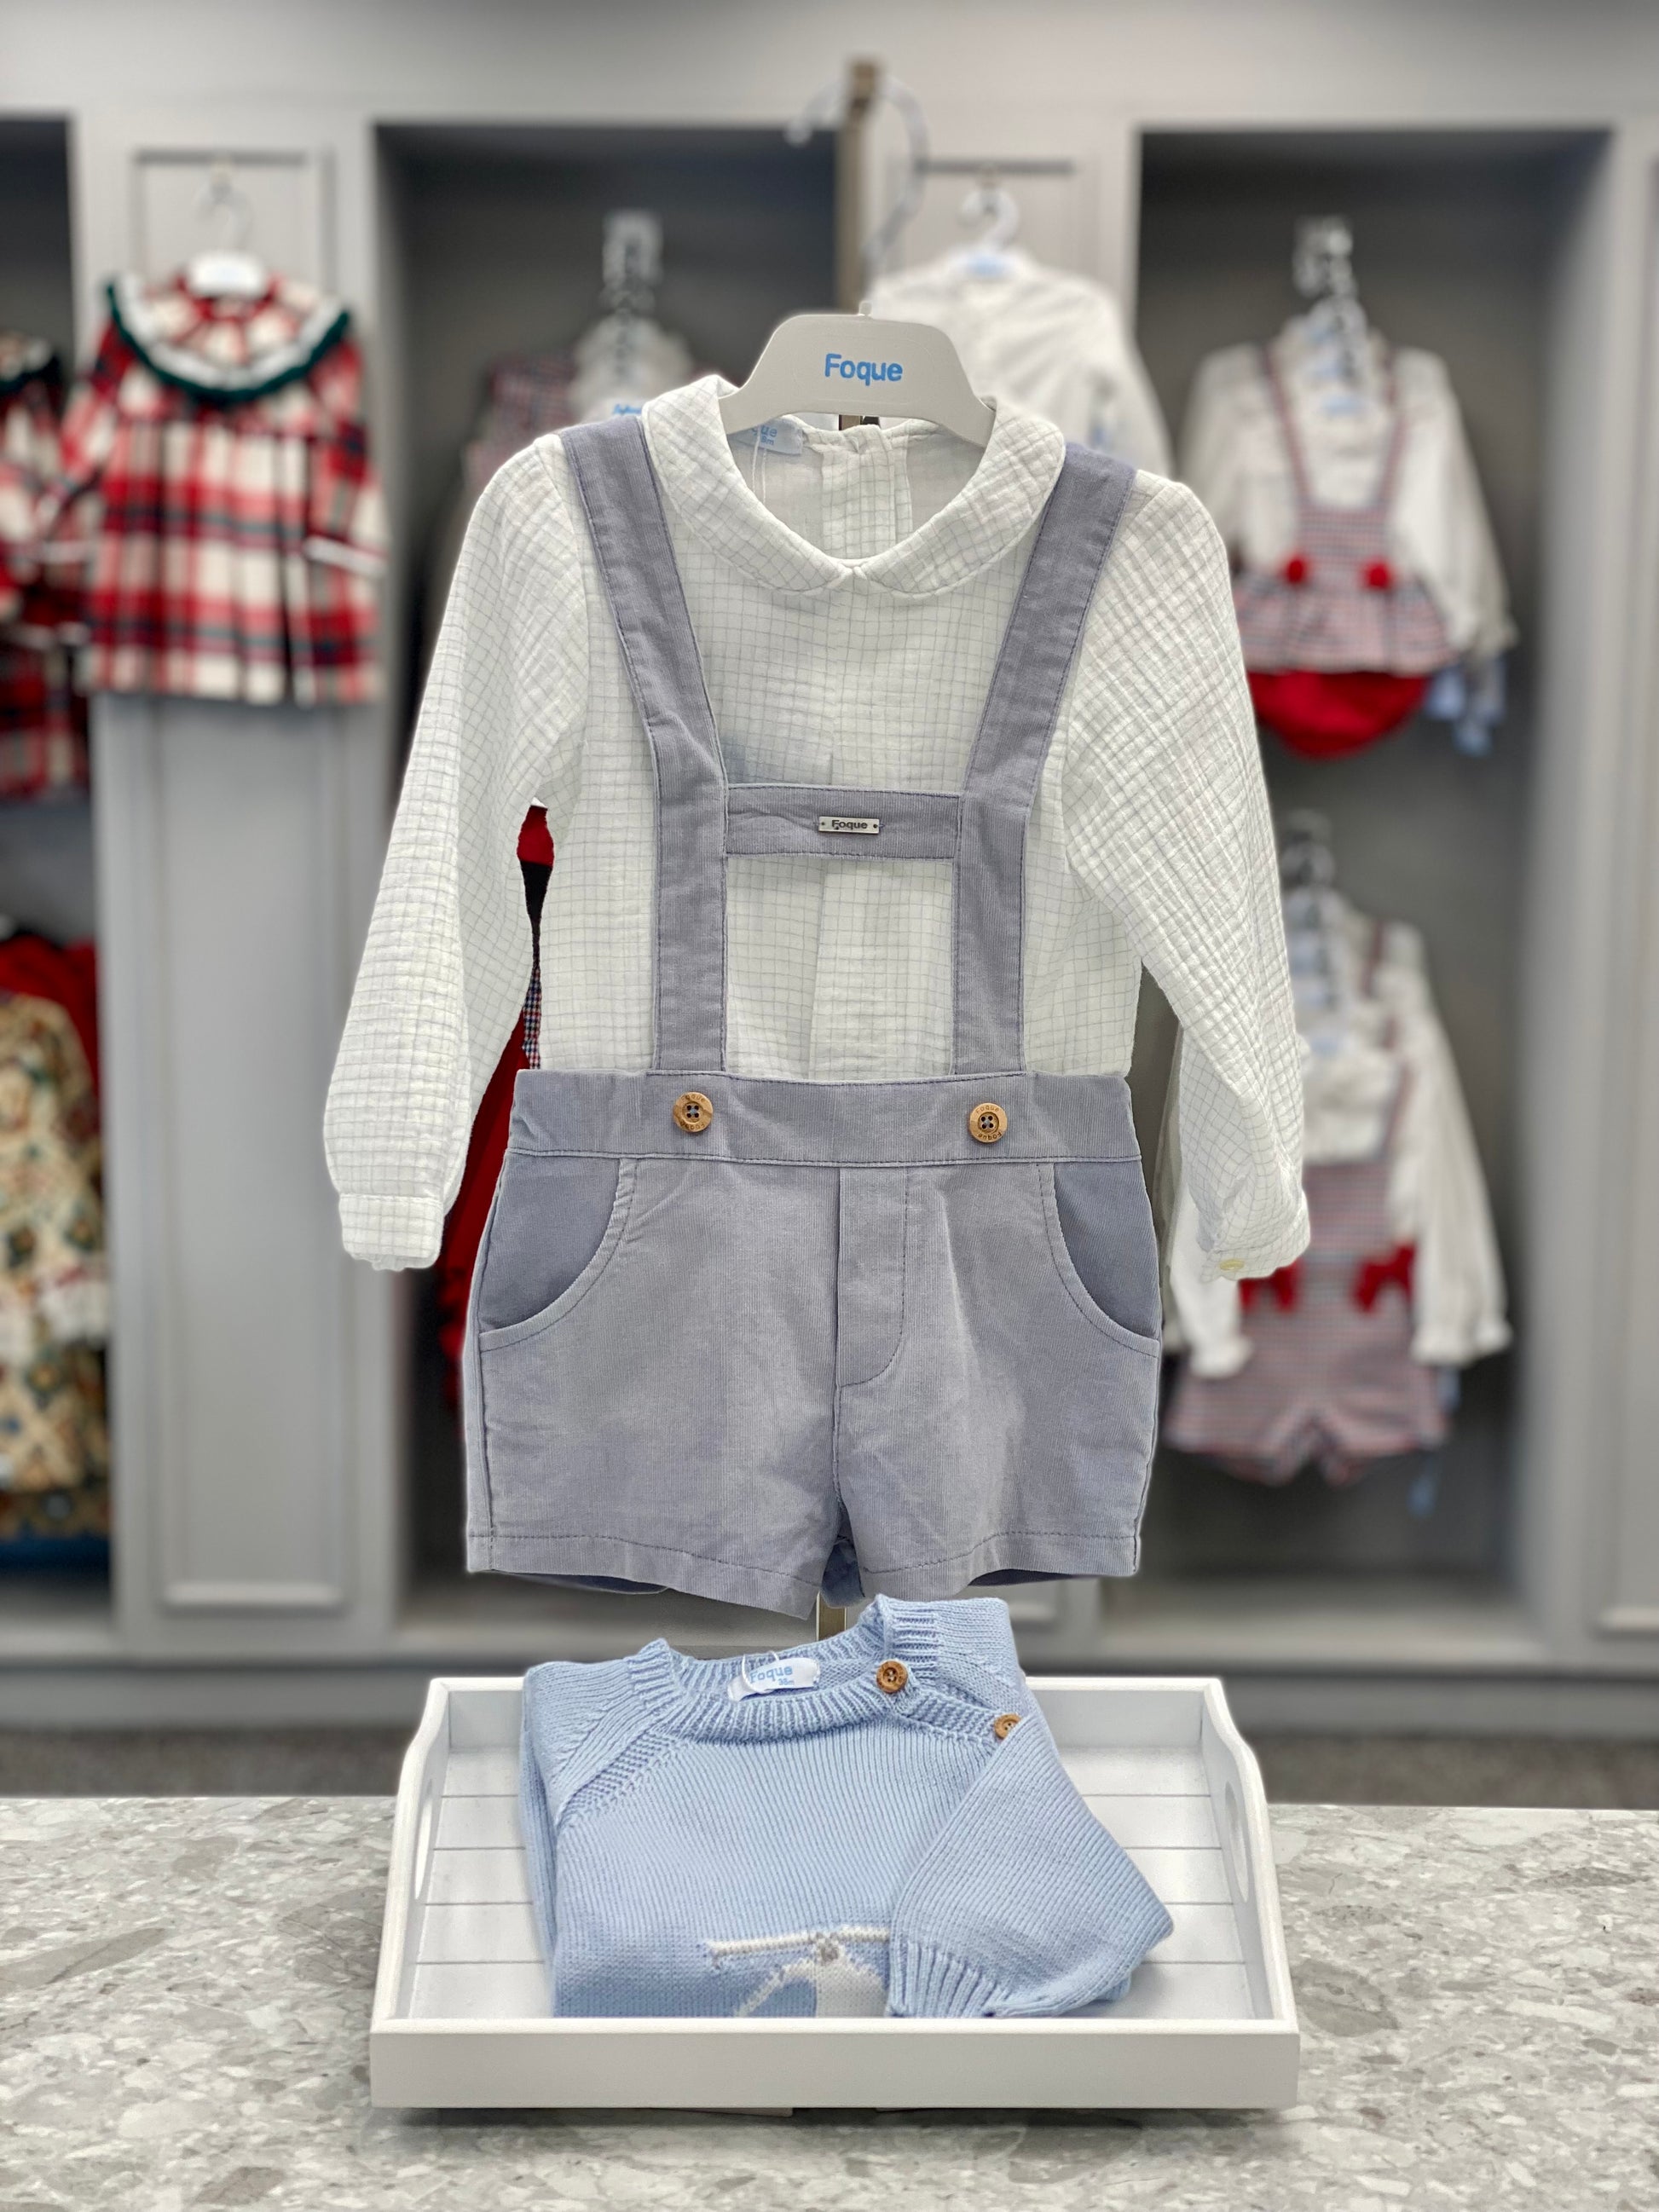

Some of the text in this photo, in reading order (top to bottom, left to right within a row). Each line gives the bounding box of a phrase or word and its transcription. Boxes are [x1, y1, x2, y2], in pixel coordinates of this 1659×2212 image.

[824, 353, 903, 386] Foque
[831, 819, 868, 830] Foque
[975, 1105, 999, 1114] Foque
[977, 1131, 1003, 1141] Foque
[749, 1666, 793, 1684] Foque
